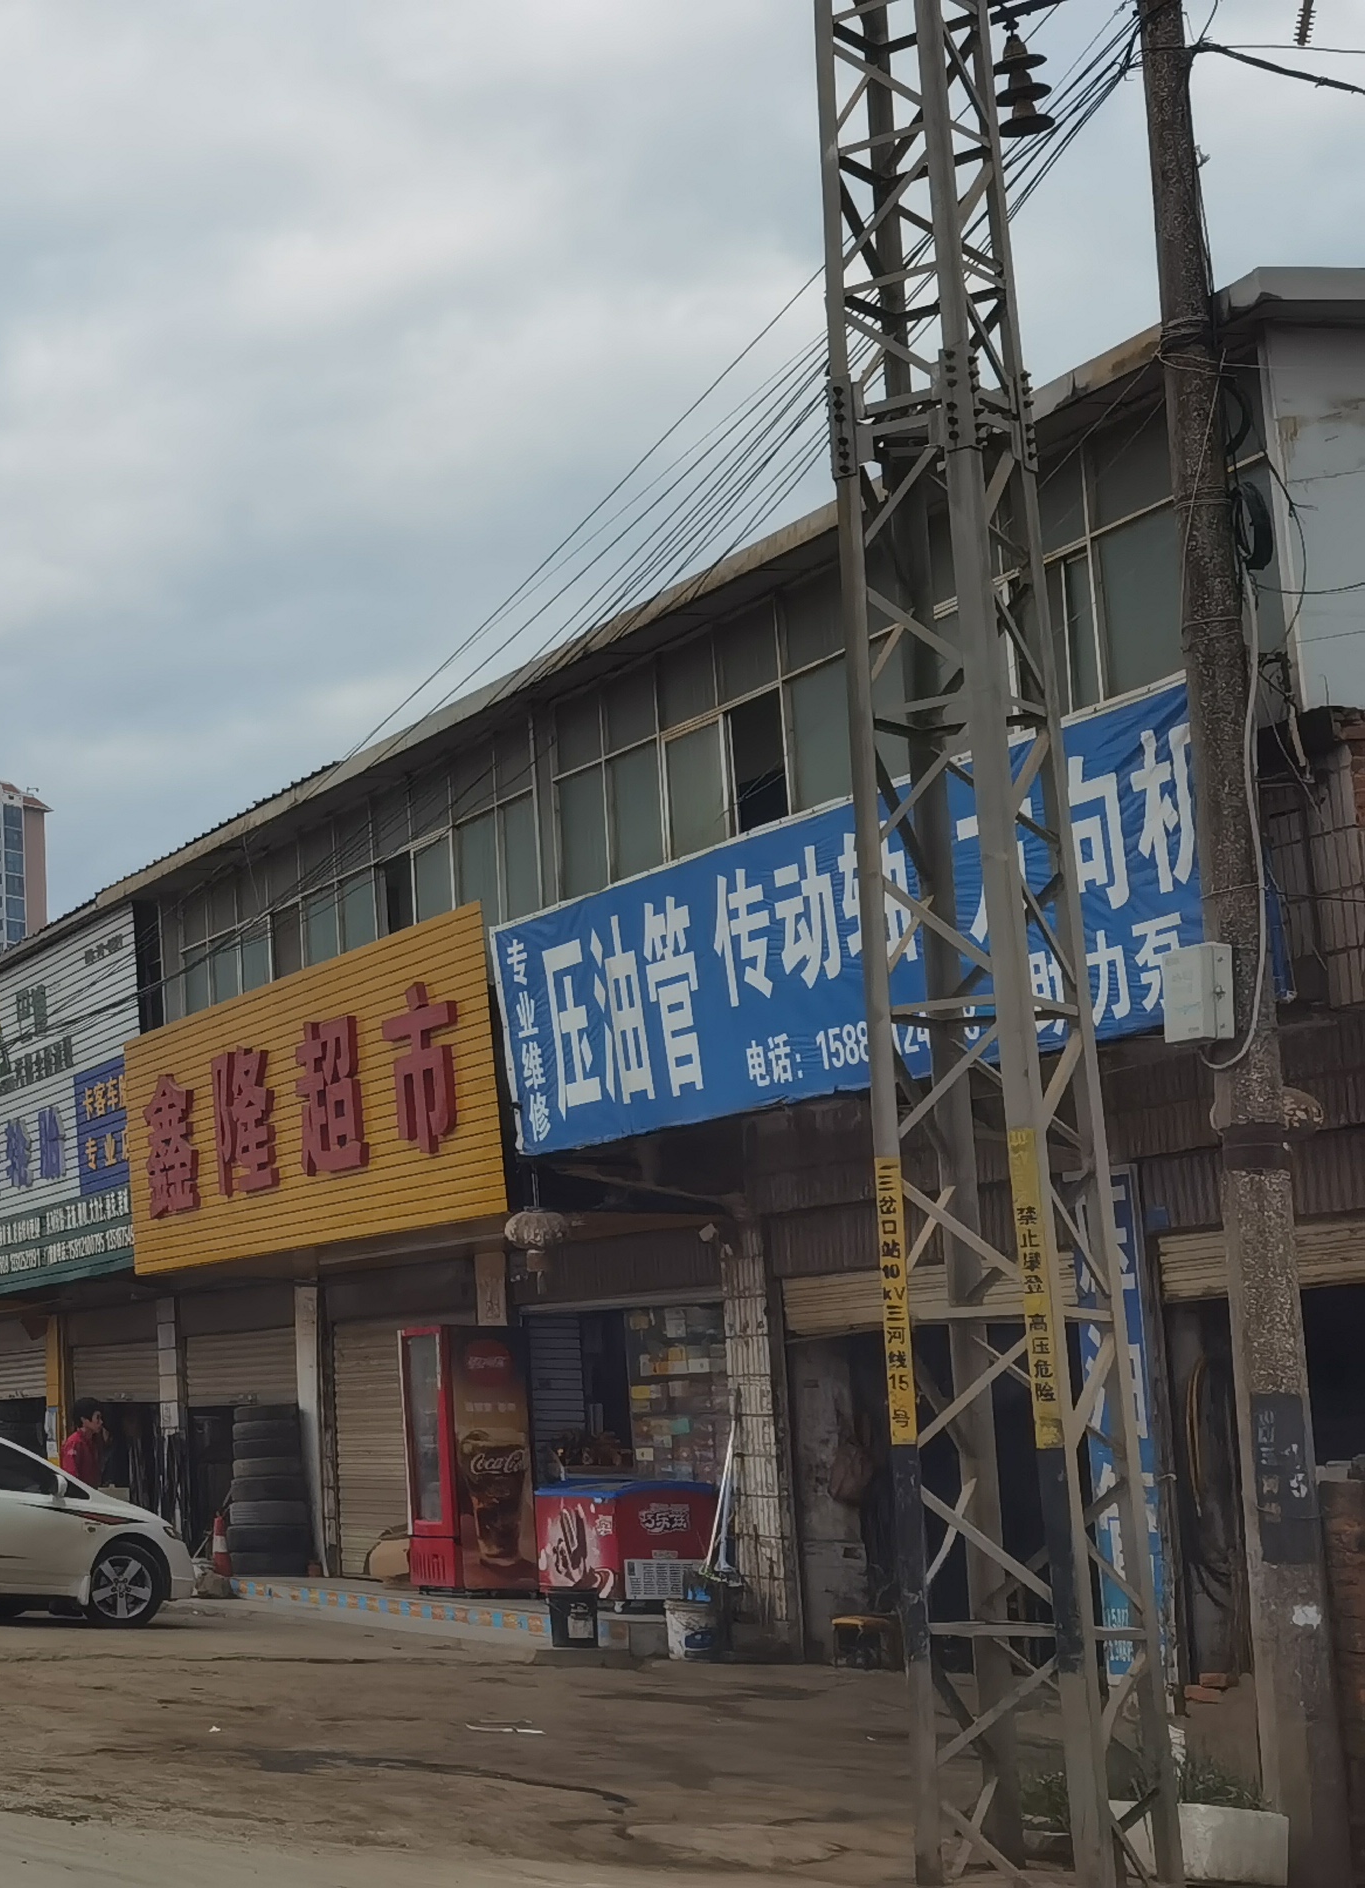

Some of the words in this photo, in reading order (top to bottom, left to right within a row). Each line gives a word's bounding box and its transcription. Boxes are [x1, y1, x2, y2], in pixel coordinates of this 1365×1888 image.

[142, 981, 458, 1220] 鑫隆超市
[506, 938, 552, 1143] 专业维修
[541, 895, 705, 1122] 压油管
[1028, 1313, 1056, 1402] 高压危险
